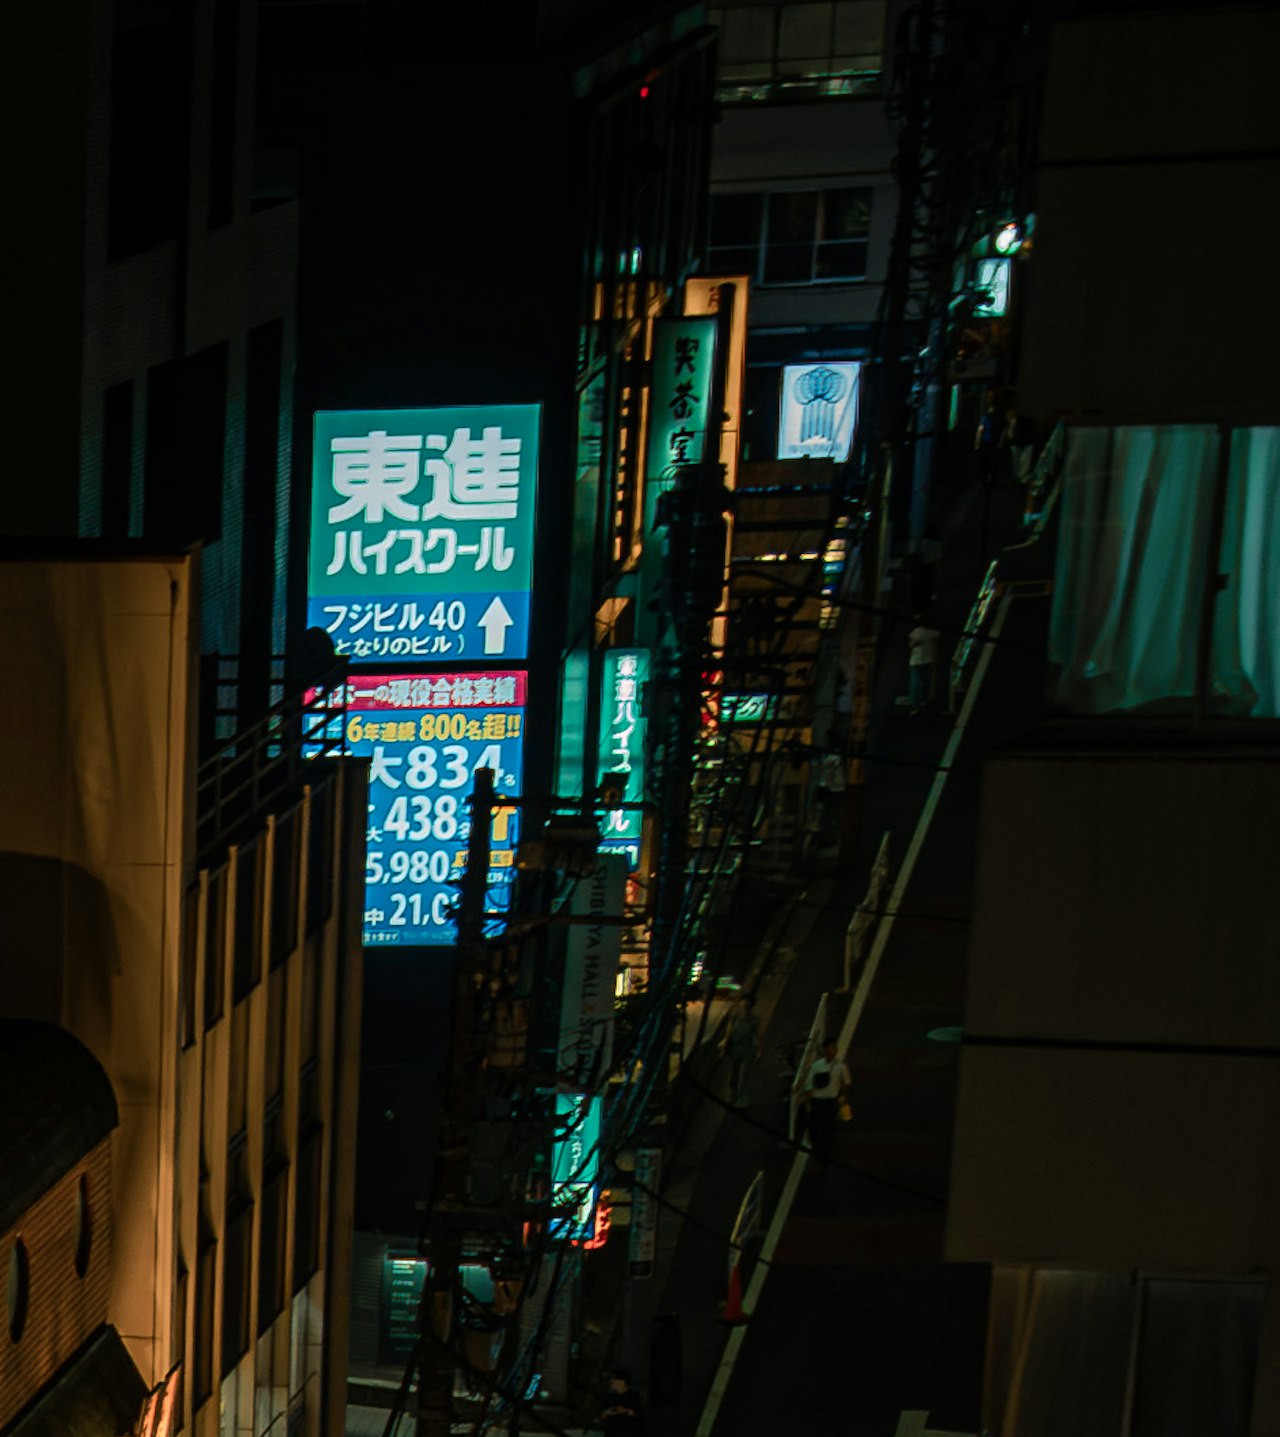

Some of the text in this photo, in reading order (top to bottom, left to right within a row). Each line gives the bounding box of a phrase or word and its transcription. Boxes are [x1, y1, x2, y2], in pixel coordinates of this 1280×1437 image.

[328, 427, 523, 525] 東進
[326, 527, 514, 576] ハイスクール
